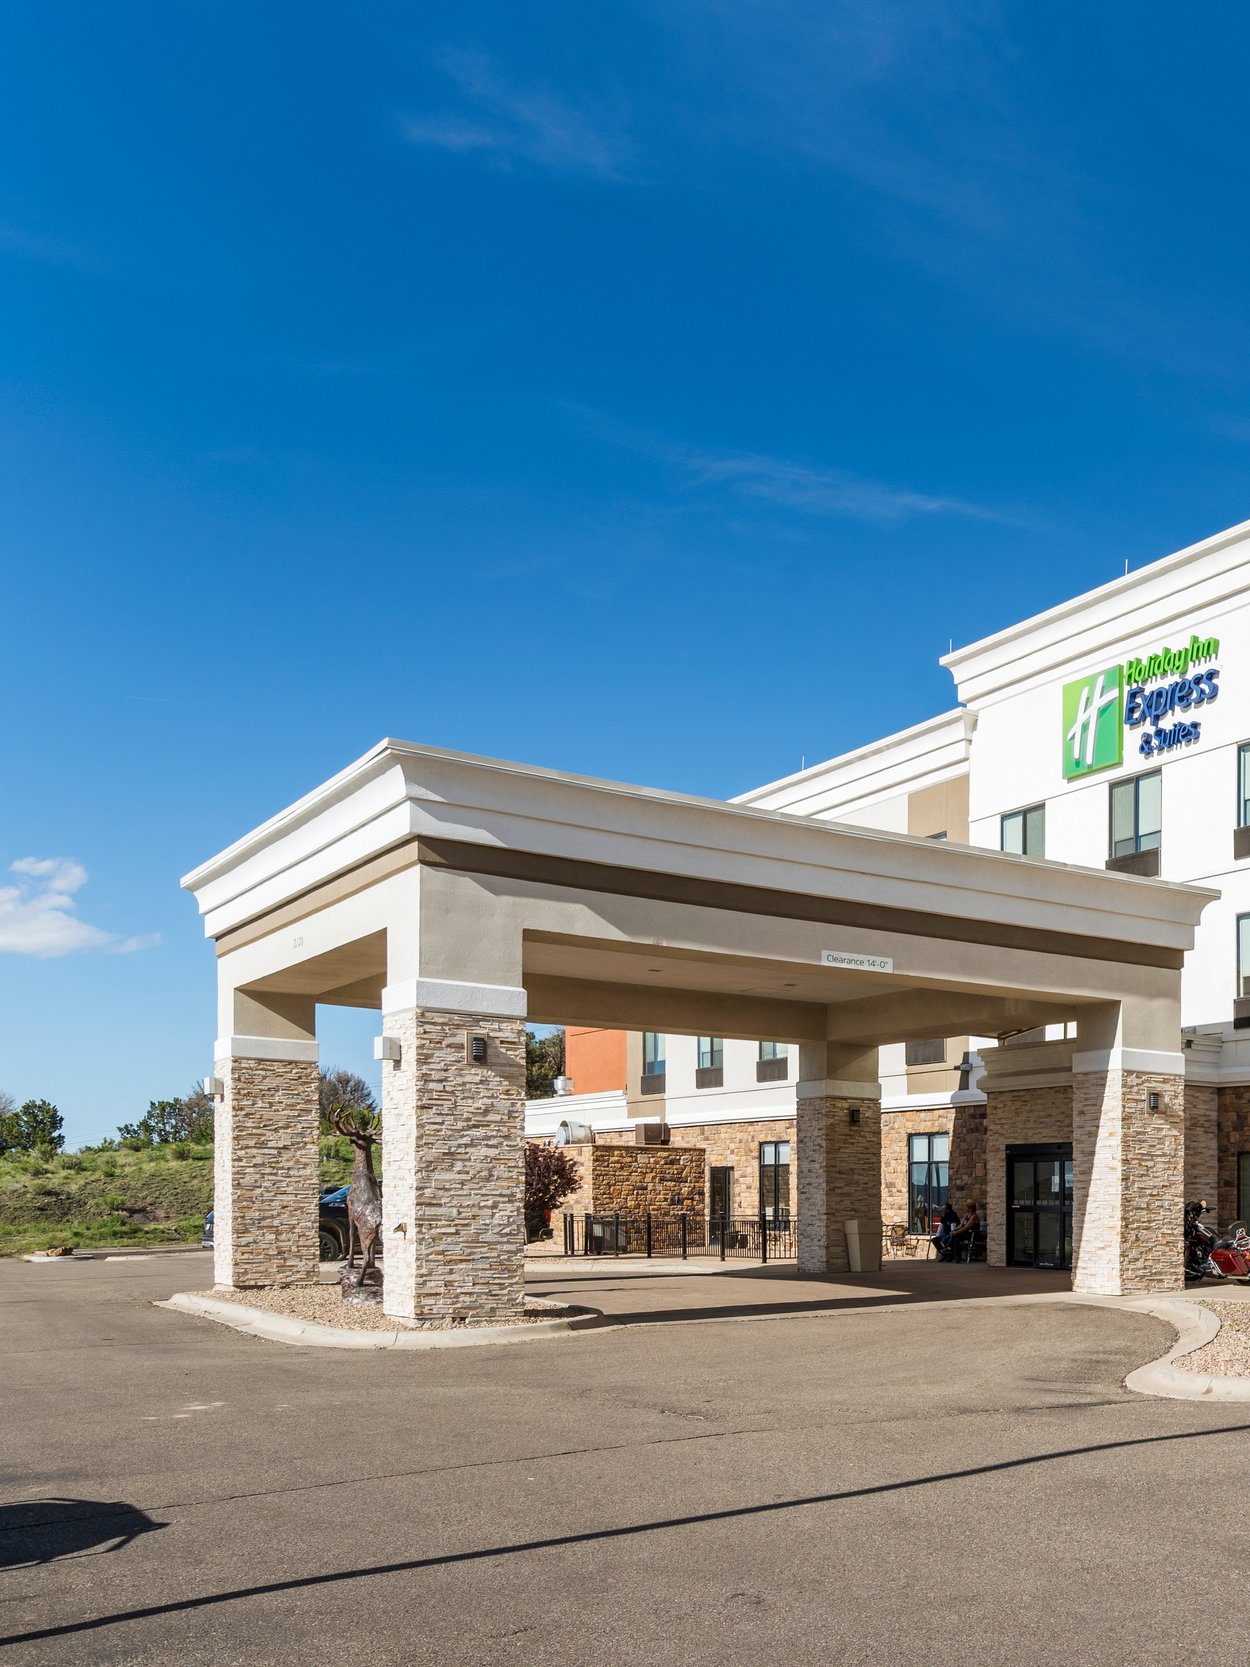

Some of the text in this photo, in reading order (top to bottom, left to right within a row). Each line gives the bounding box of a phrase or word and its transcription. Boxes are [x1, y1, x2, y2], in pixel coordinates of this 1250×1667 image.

[1125, 634, 1220, 686] Holiday Inn
[1124, 668, 1220, 727] Express
[1139, 721, 1202, 755] & Suites
[826, 954, 865, 967] Clearance
